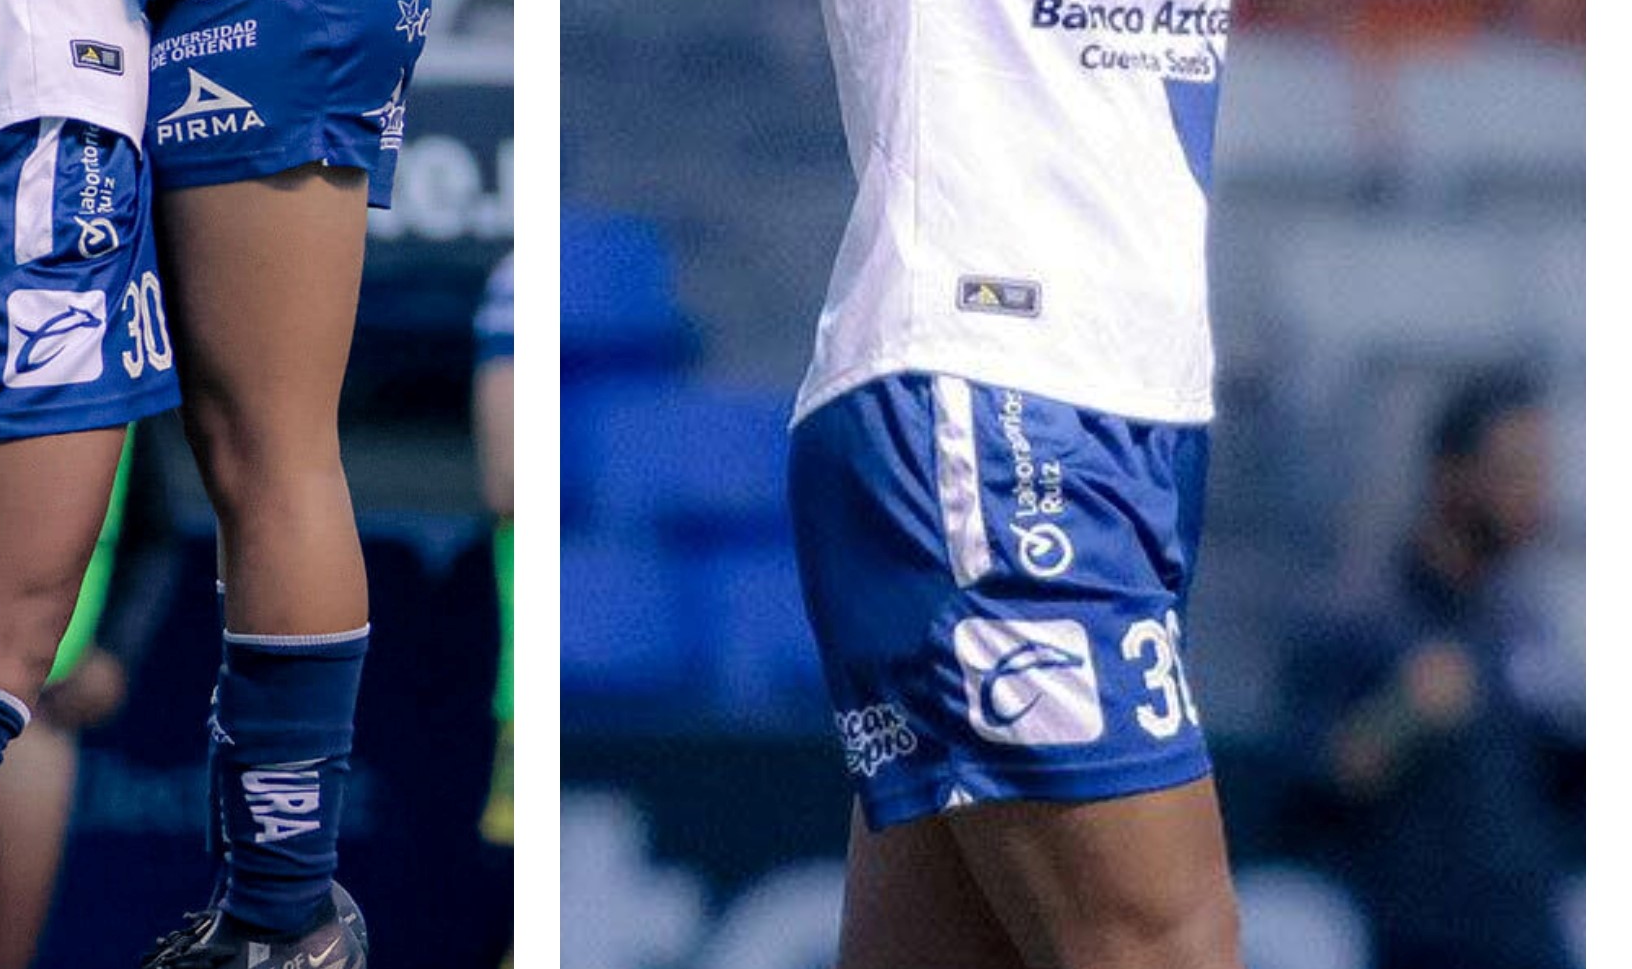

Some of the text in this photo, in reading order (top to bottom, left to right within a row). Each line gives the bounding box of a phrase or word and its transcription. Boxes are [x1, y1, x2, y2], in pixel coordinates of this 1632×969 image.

[171, 31, 258, 62] ORIENTE
[157, 110, 265, 145] PIRMA
[121, 271, 173, 379] 30
[240, 760, 321, 844] URA
